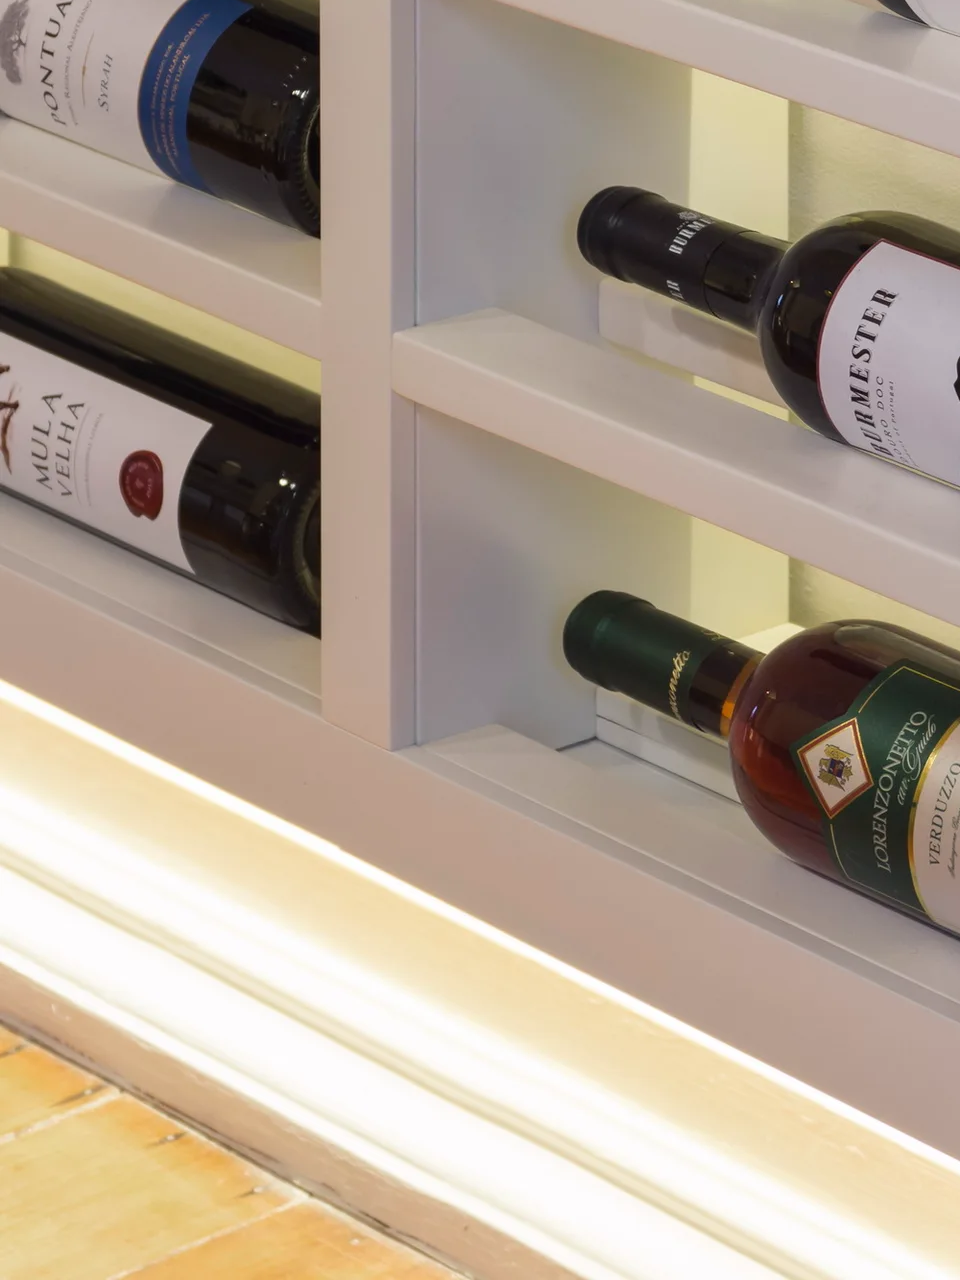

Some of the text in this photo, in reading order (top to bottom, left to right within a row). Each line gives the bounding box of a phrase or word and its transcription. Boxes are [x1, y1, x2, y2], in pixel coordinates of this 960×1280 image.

[97, 53, 114, 112] SYRAH
[848, 287, 899, 458] BURMESTER
[875, 376, 885, 411] DOC
[31, 392, 63, 491] MULA
[54, 402, 85, 498] VELHA
[872, 710, 928, 873] LORENZONETTO
[901, 713, 937, 782] Guido
